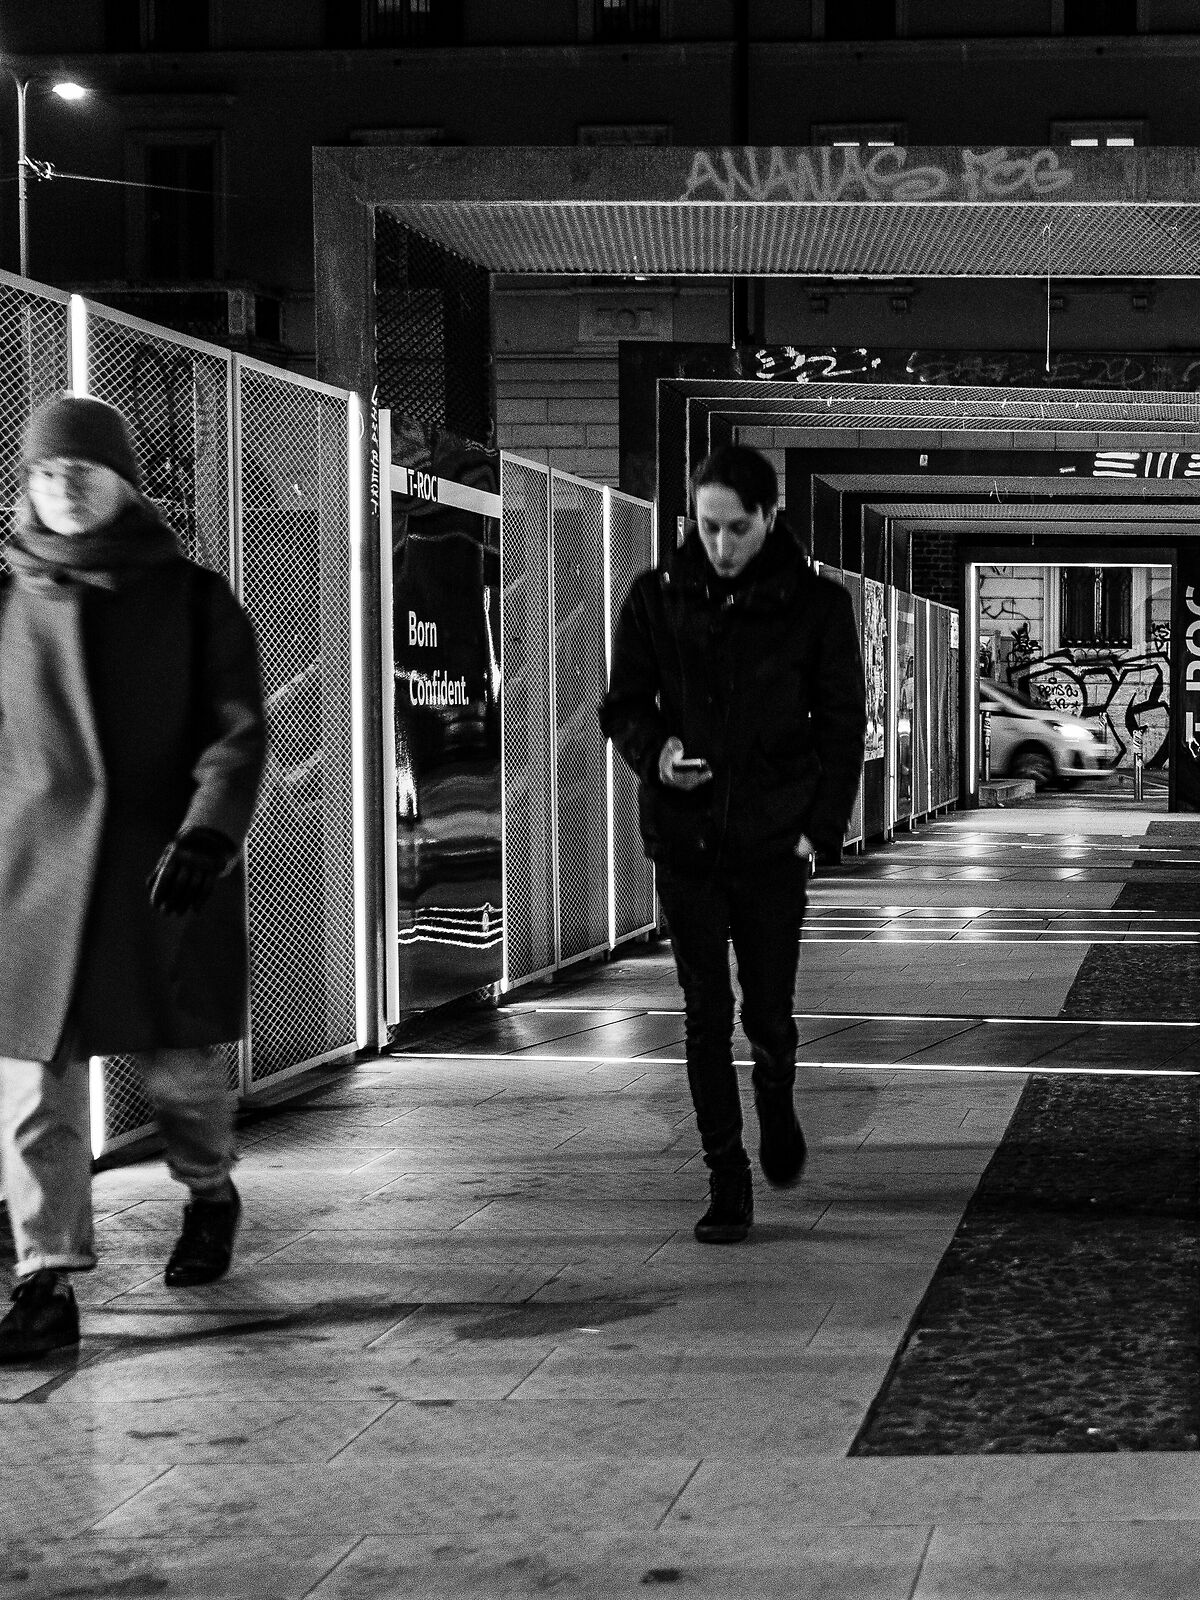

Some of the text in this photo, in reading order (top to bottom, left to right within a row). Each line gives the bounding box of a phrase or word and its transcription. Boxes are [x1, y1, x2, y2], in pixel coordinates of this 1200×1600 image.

[408, 468, 437, 502] T-ROC
[408, 610, 437, 647] Born
[409, 670, 469, 706] Confident.
